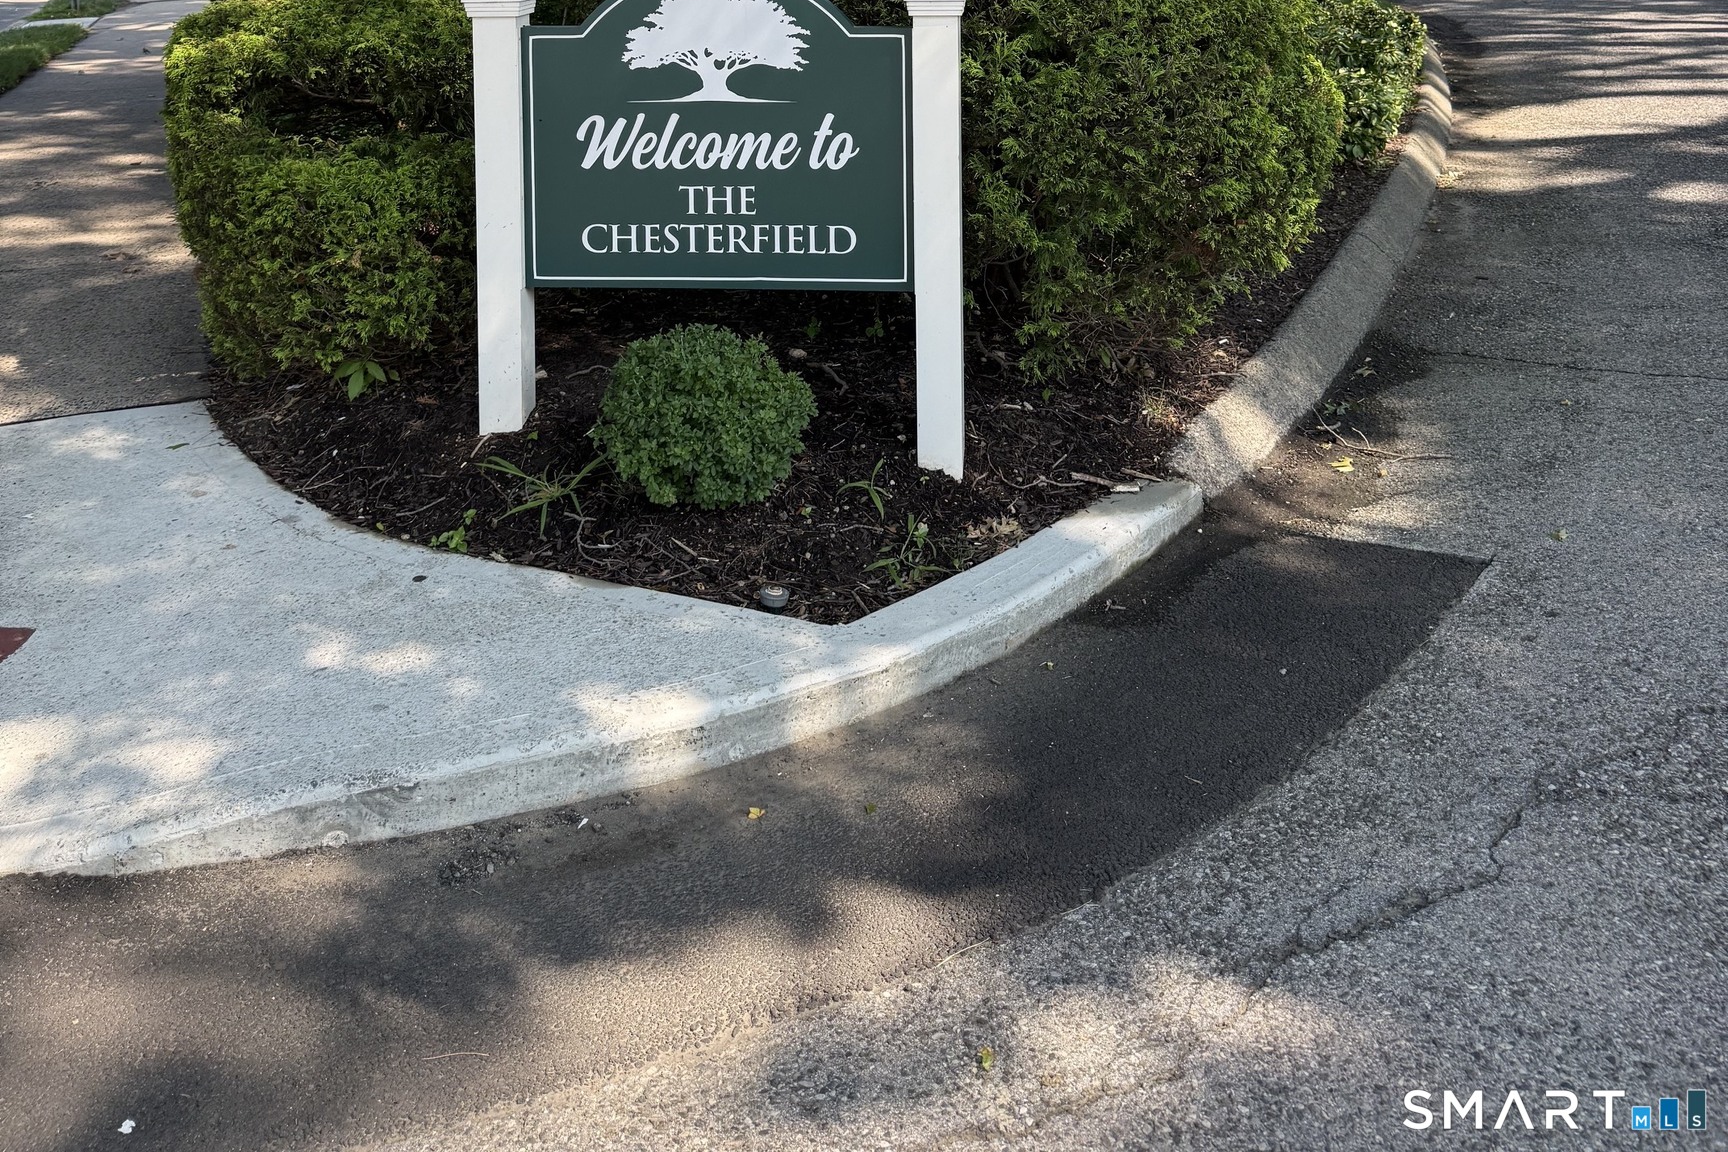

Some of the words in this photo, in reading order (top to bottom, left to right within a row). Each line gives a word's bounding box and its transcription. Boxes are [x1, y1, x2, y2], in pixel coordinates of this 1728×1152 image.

[576, 112, 801, 171] Welcome
[808, 112, 860, 171] to
[678, 184, 758, 216] THE
[581, 223, 858, 255] CHESTERFIELD
